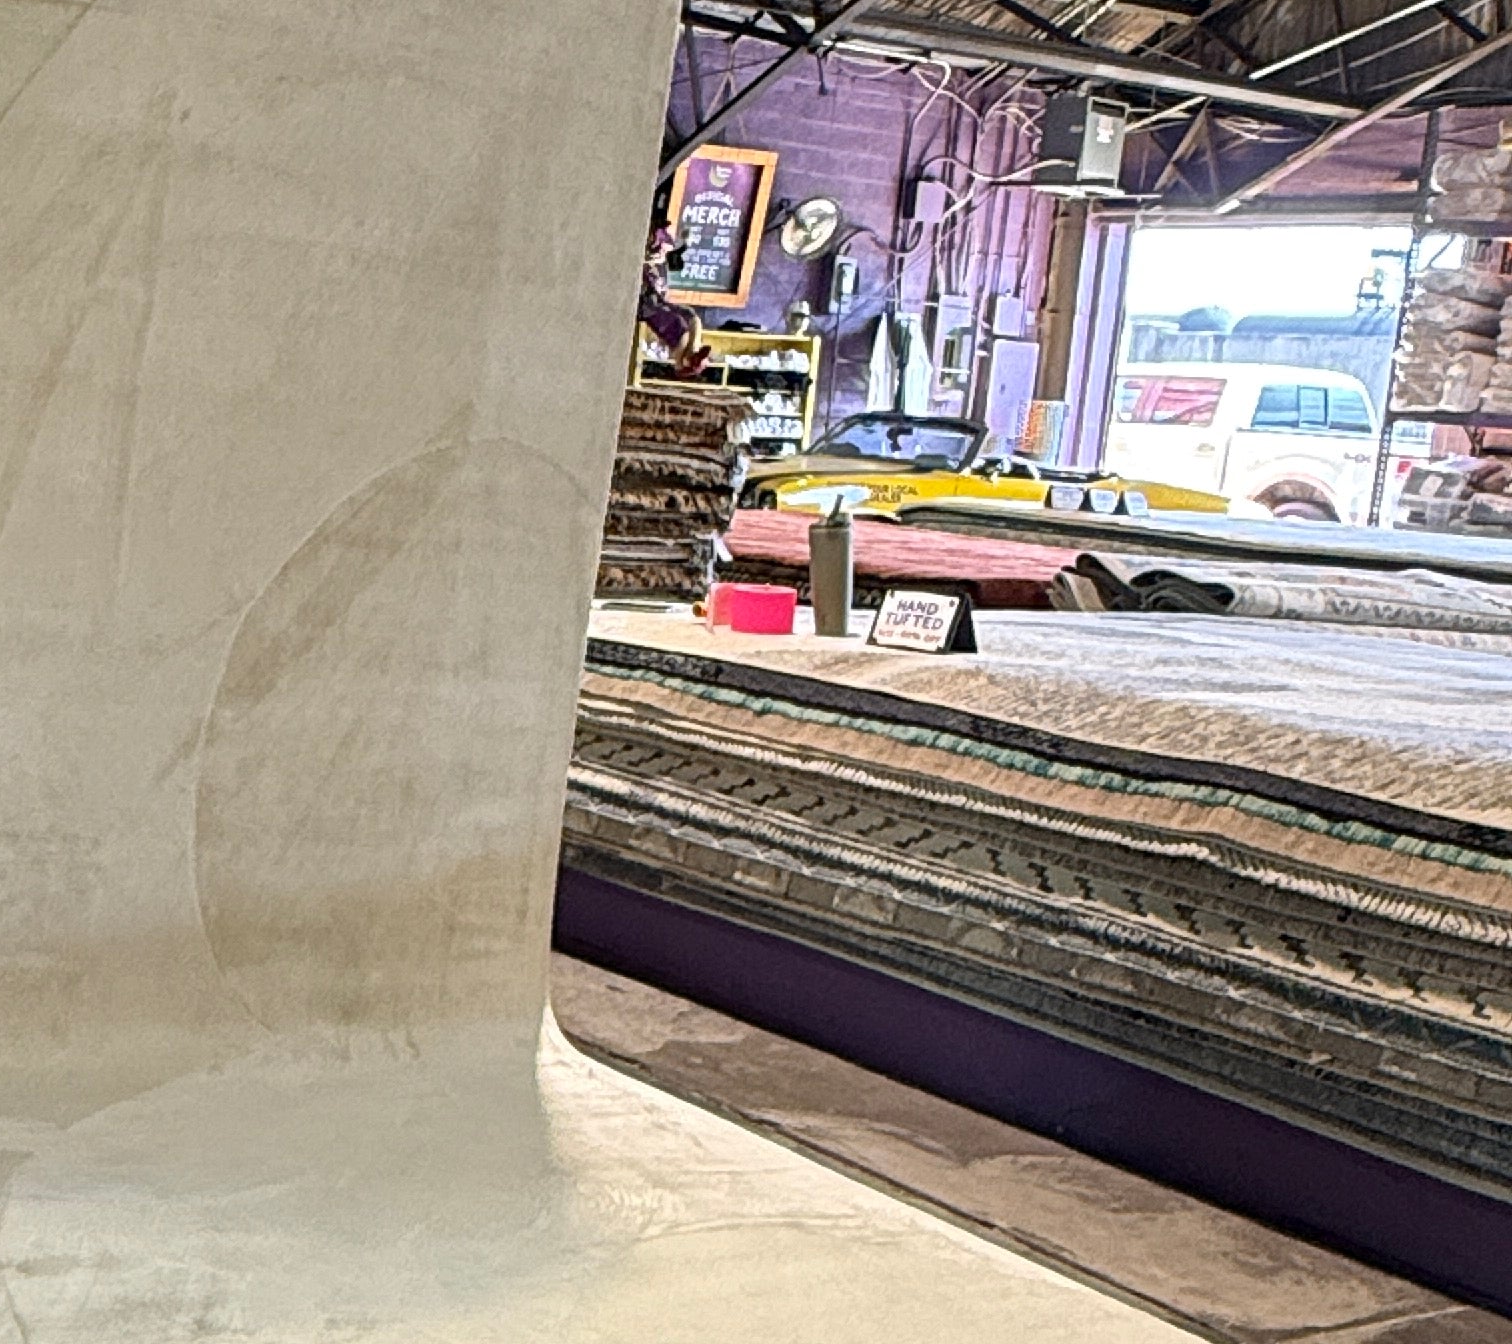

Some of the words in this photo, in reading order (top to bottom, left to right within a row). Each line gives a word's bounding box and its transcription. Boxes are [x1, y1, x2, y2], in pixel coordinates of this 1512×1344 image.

[682, 204, 742, 227] MERCH
[680, 263, 720, 281] FREE
[896, 599, 940, 616] HAND
[885, 611, 944, 631] TUFTED
